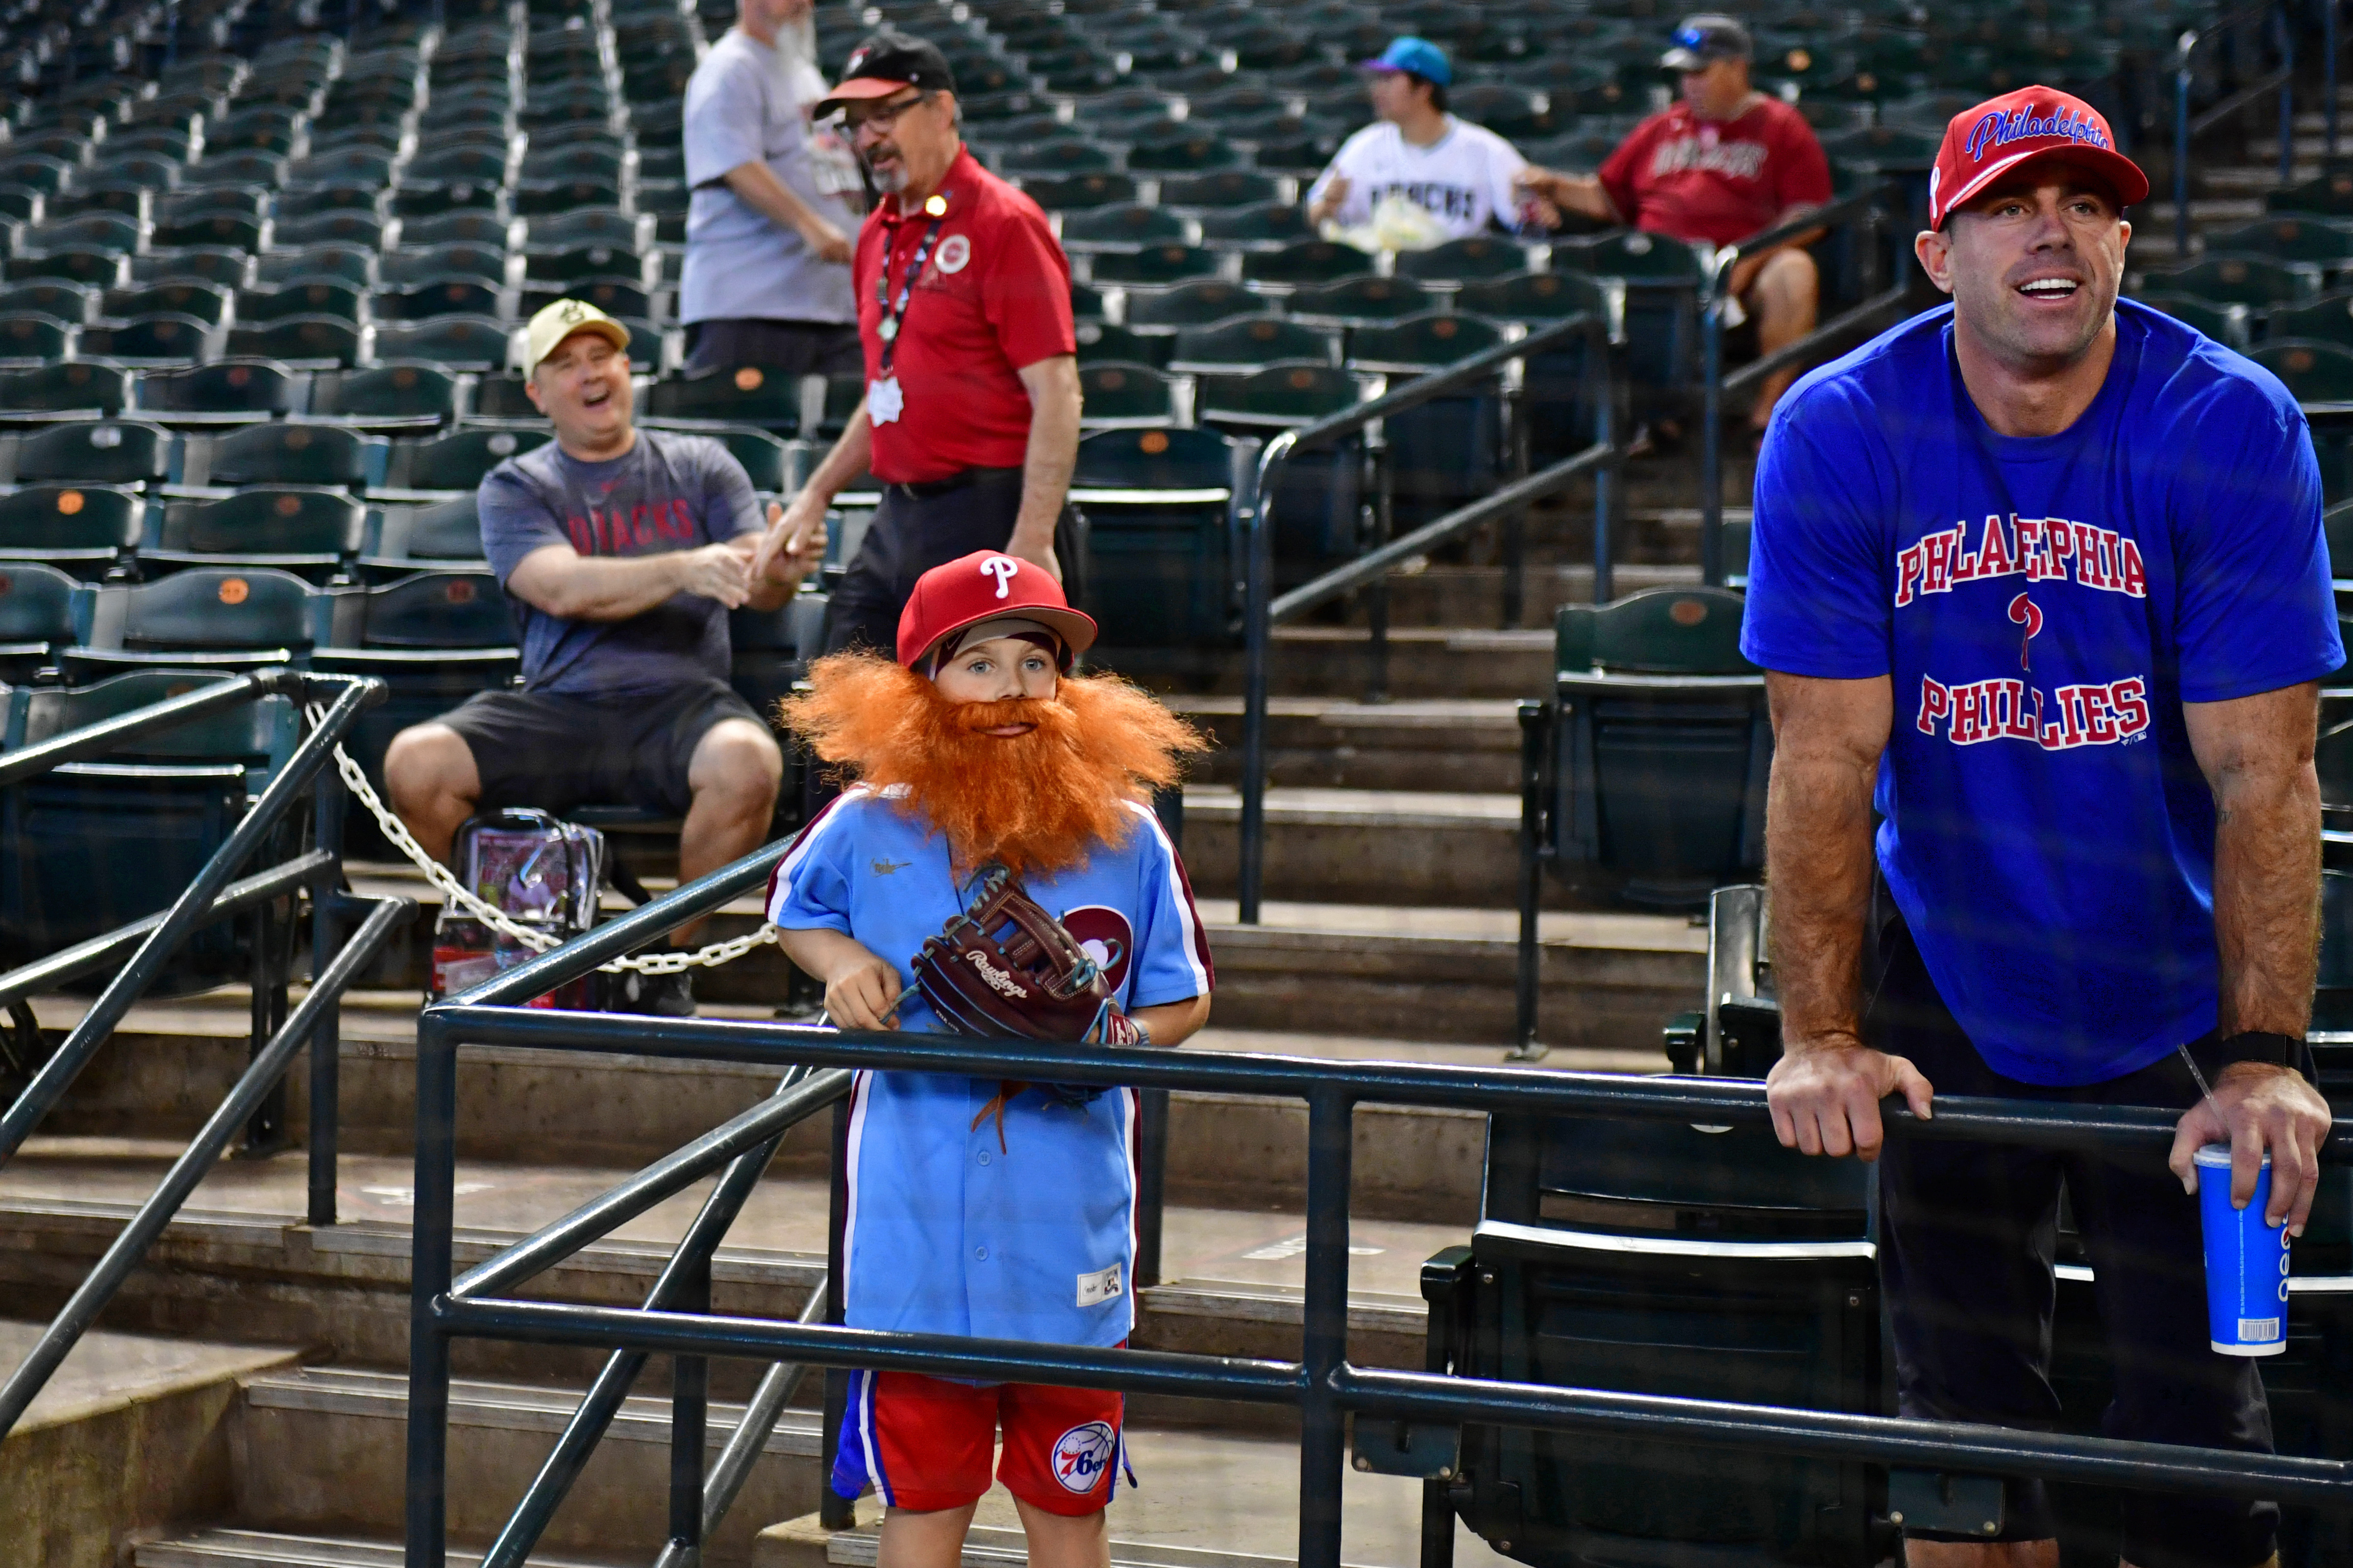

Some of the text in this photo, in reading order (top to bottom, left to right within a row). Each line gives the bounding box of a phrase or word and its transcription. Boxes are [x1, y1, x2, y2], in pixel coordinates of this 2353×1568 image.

[1965, 103, 2109, 162] Philadelphia
[980, 557, 1018, 599] P
[1917, 673, 2151, 751] PHILLIES
[966, 950, 1028, 999] Rawlings
